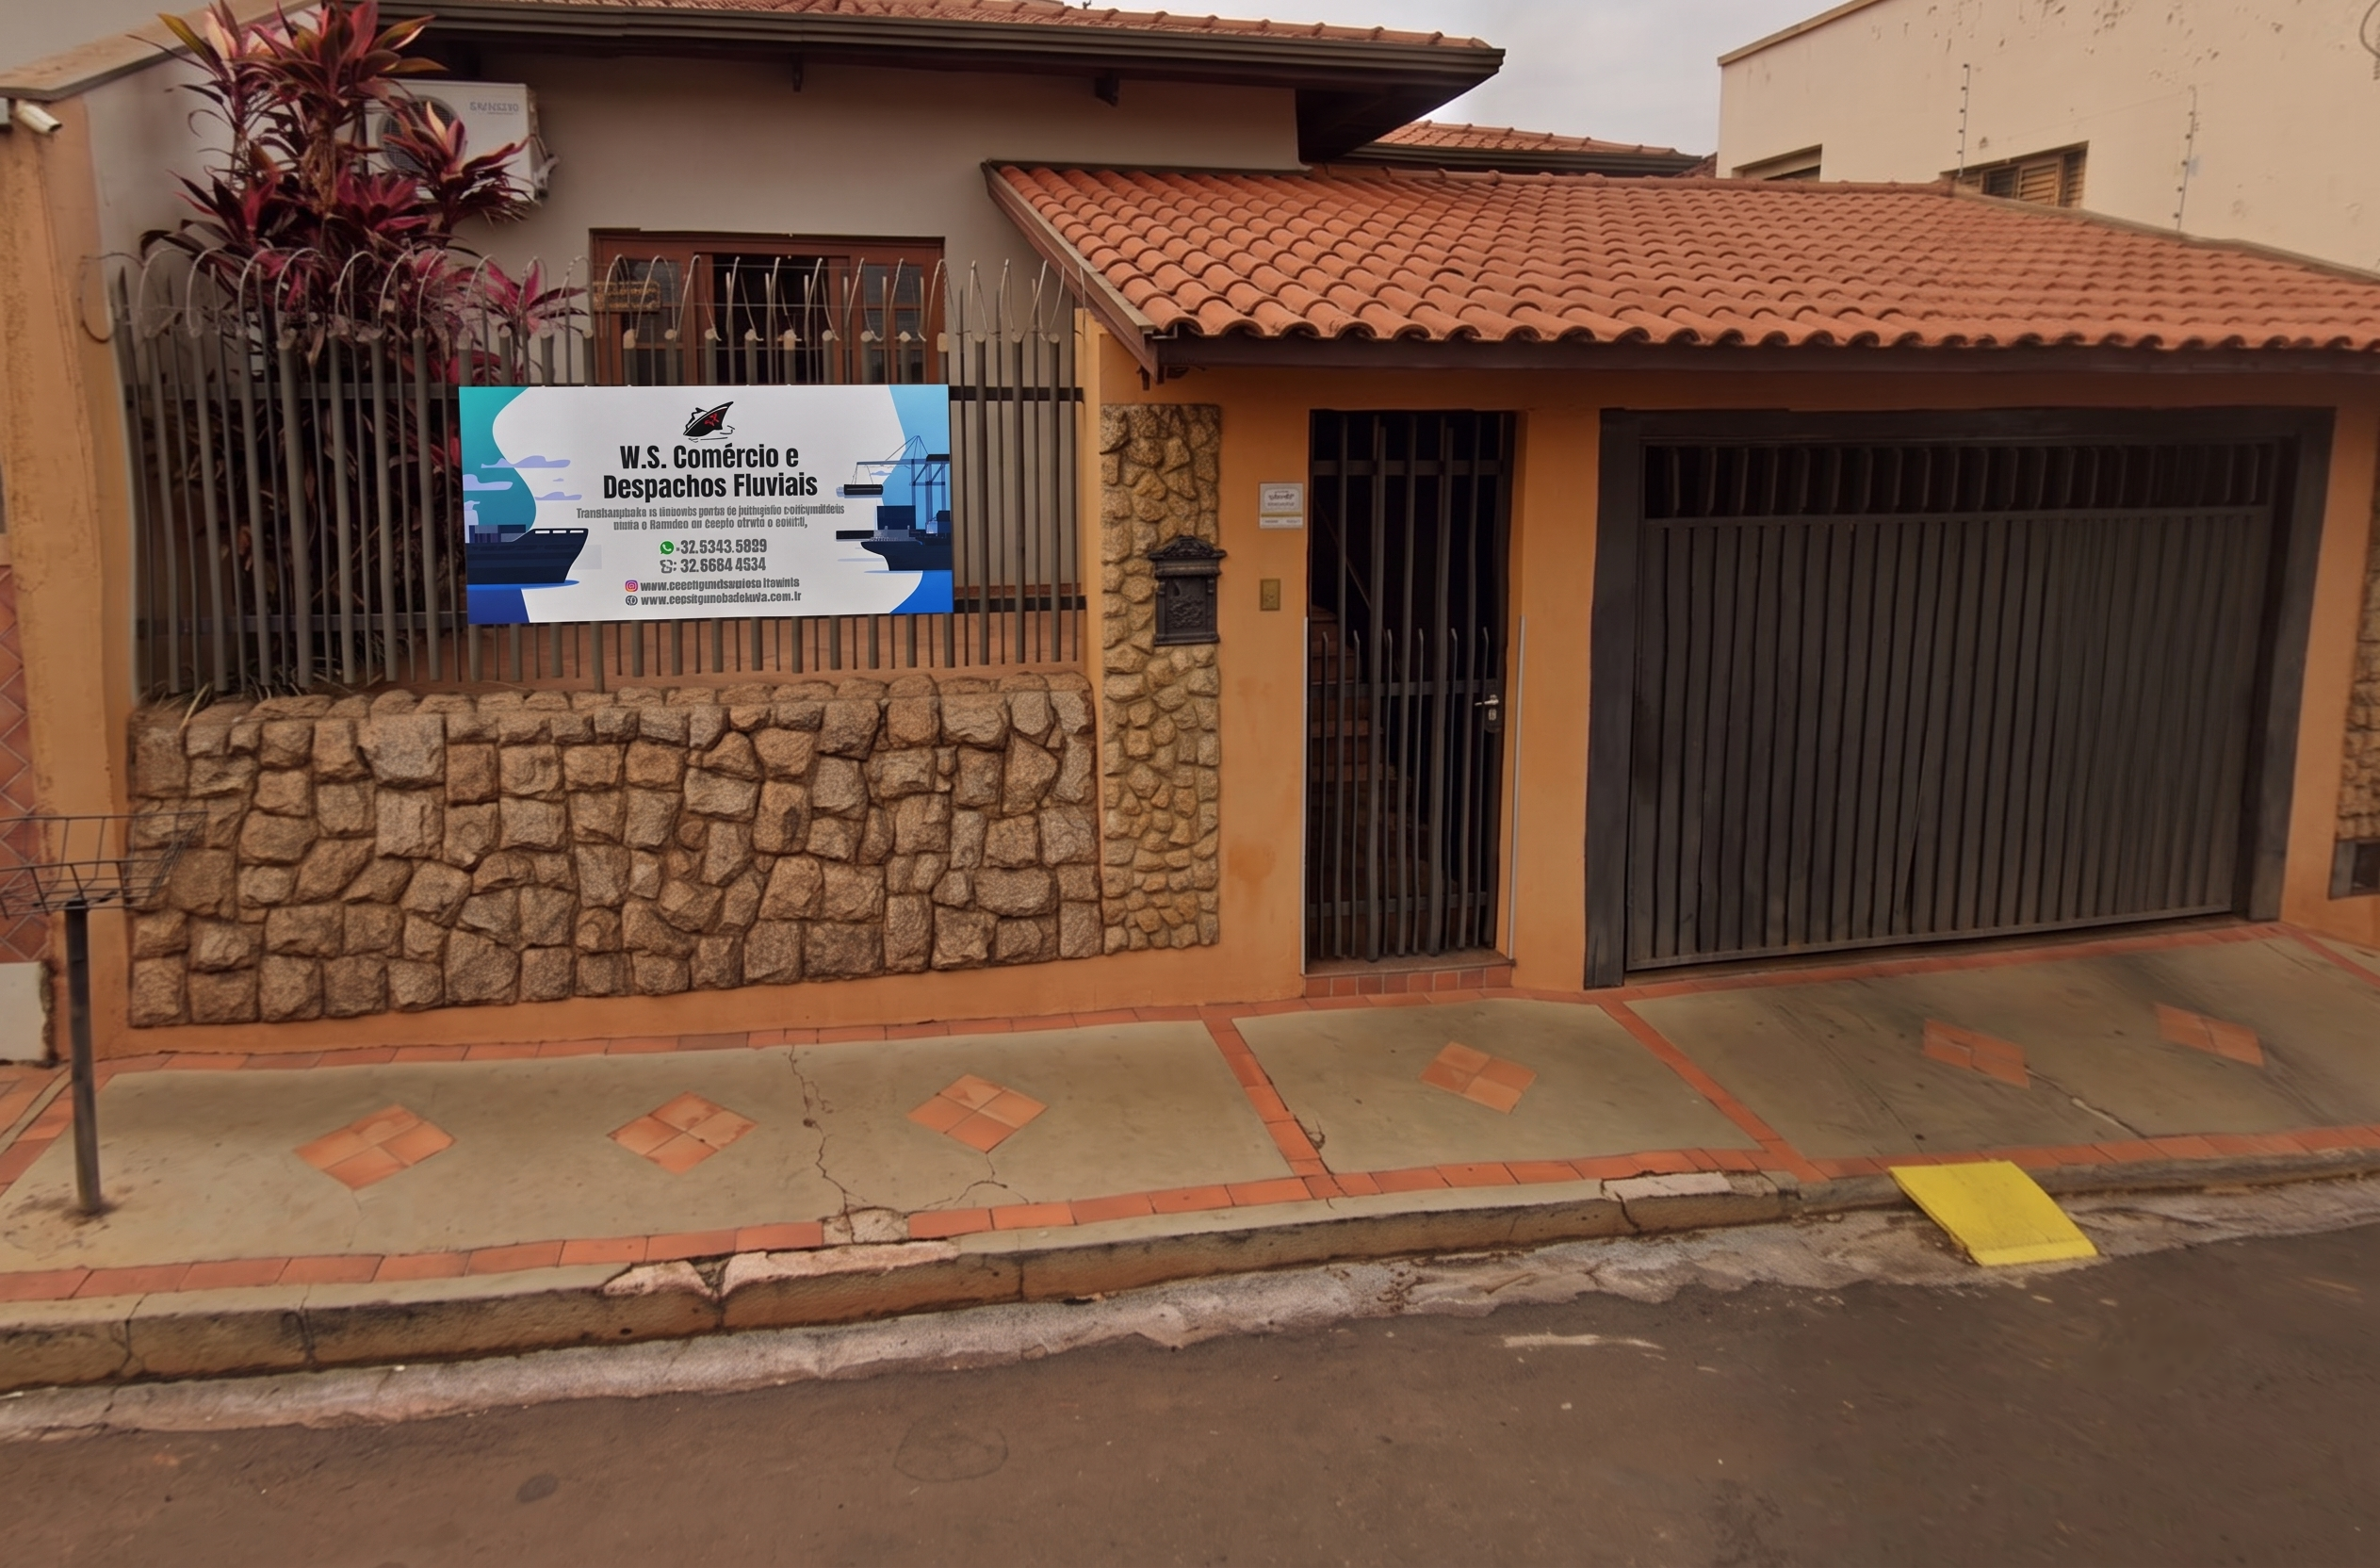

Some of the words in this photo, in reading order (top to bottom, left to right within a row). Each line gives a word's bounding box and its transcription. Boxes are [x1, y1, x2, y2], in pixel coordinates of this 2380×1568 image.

[619, 445, 667, 469] W.S.
[673, 442, 779, 468] Comércio
[786, 448, 799, 467] e
[603, 474, 727, 503] Despachos
[733, 471, 818, 498] Fluviais
